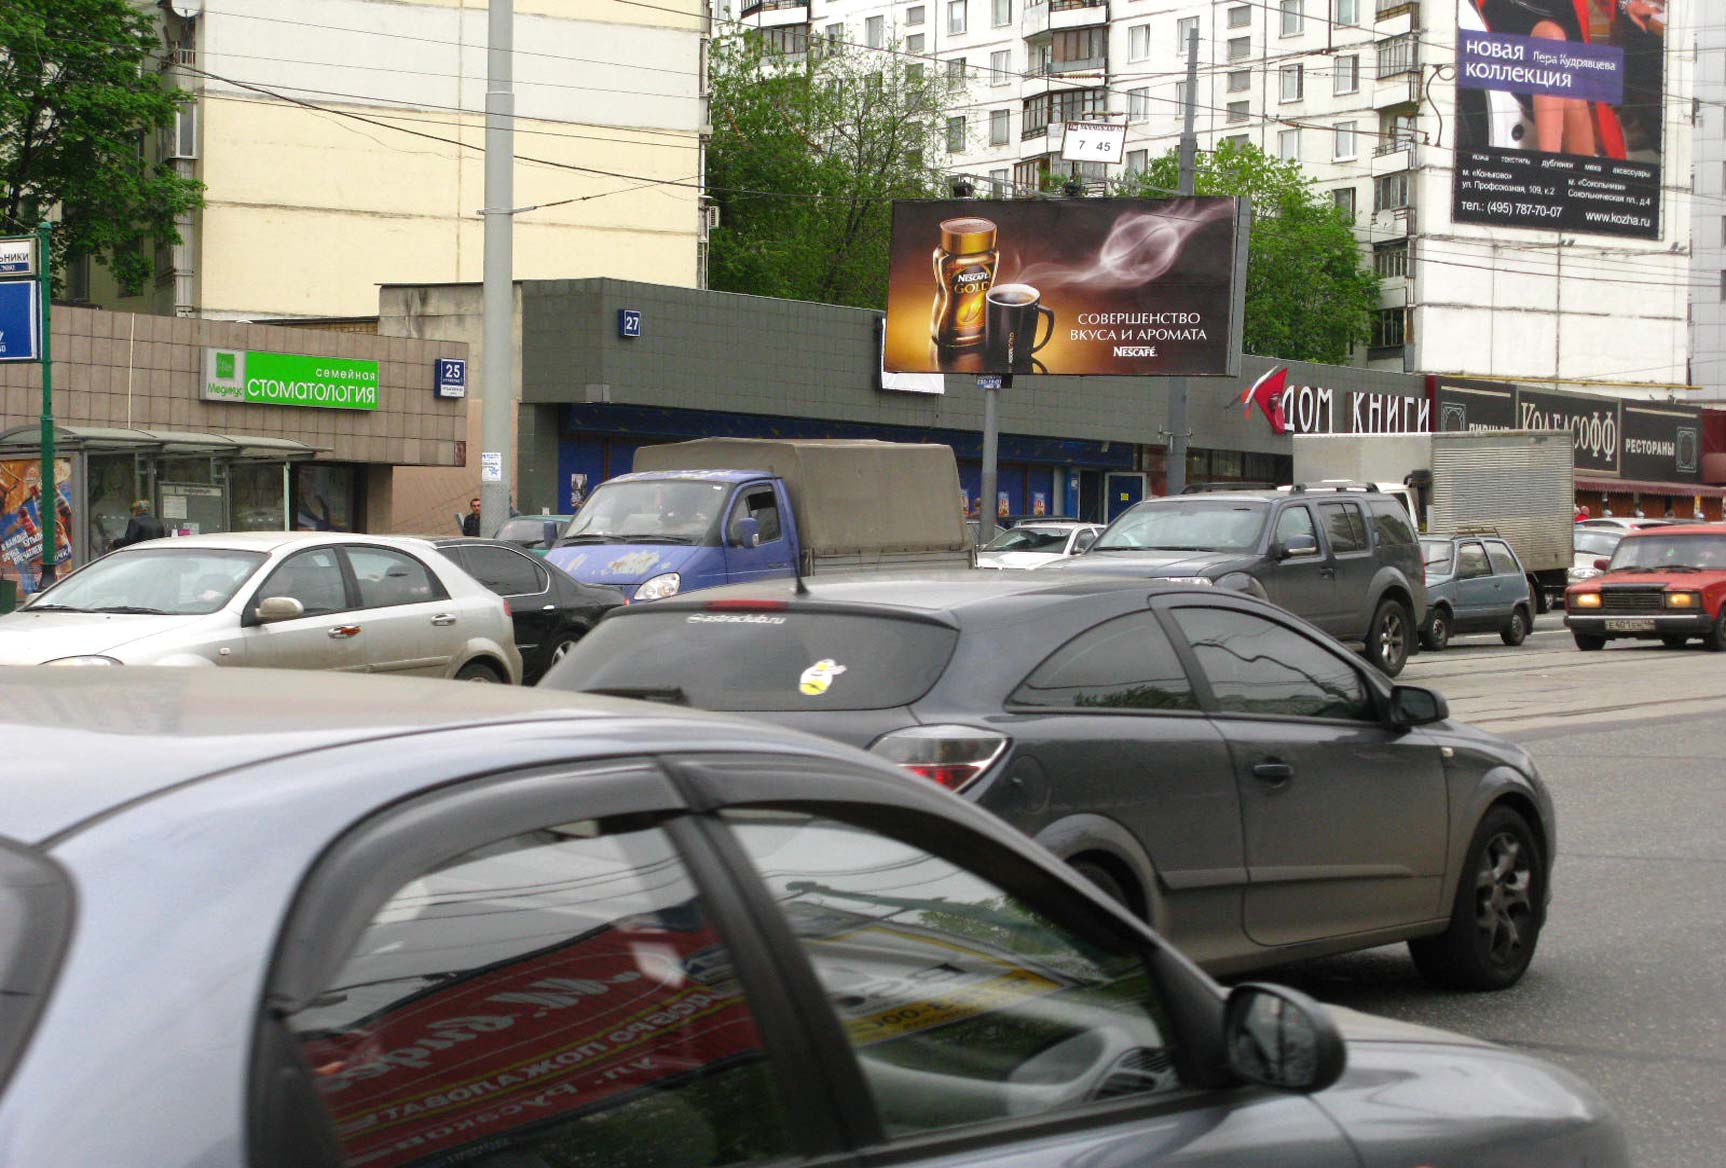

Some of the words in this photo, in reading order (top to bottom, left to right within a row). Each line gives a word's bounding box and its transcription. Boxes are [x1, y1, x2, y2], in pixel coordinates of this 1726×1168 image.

[1466, 39, 1524, 61] новая
[1559, 54, 1616, 71] Кудрявцева
[1466, 62, 1572, 88] коллекция
[1096, 142, 1111, 152] 45
[1568, 188, 1625, 203] Сокольническая
[1461, 200, 1484, 212] тел.:
[1487, 200, 1513, 216] (495)
[1515, 203, 1563, 218] 787-70-07
[1585, 211, 1651, 228] www.kozha.ru
[626, 316, 639, 331] 27
[1078, 312, 1201, 325] СОВЕРШЕНСТВО
[1070, 328, 1117, 341] ВКУСА
[1121, 328, 1133, 341] И
[1136, 328, 1207, 341] АРОМАТА
[315, 367, 376, 381] семейная
[445, 363, 461, 378] 25
[1282, 385, 1333, 433] ДОМ
[1353, 391, 1431, 433] КНИГИ
[1625, 438, 1675, 457] РЕСТОРАНЫ
